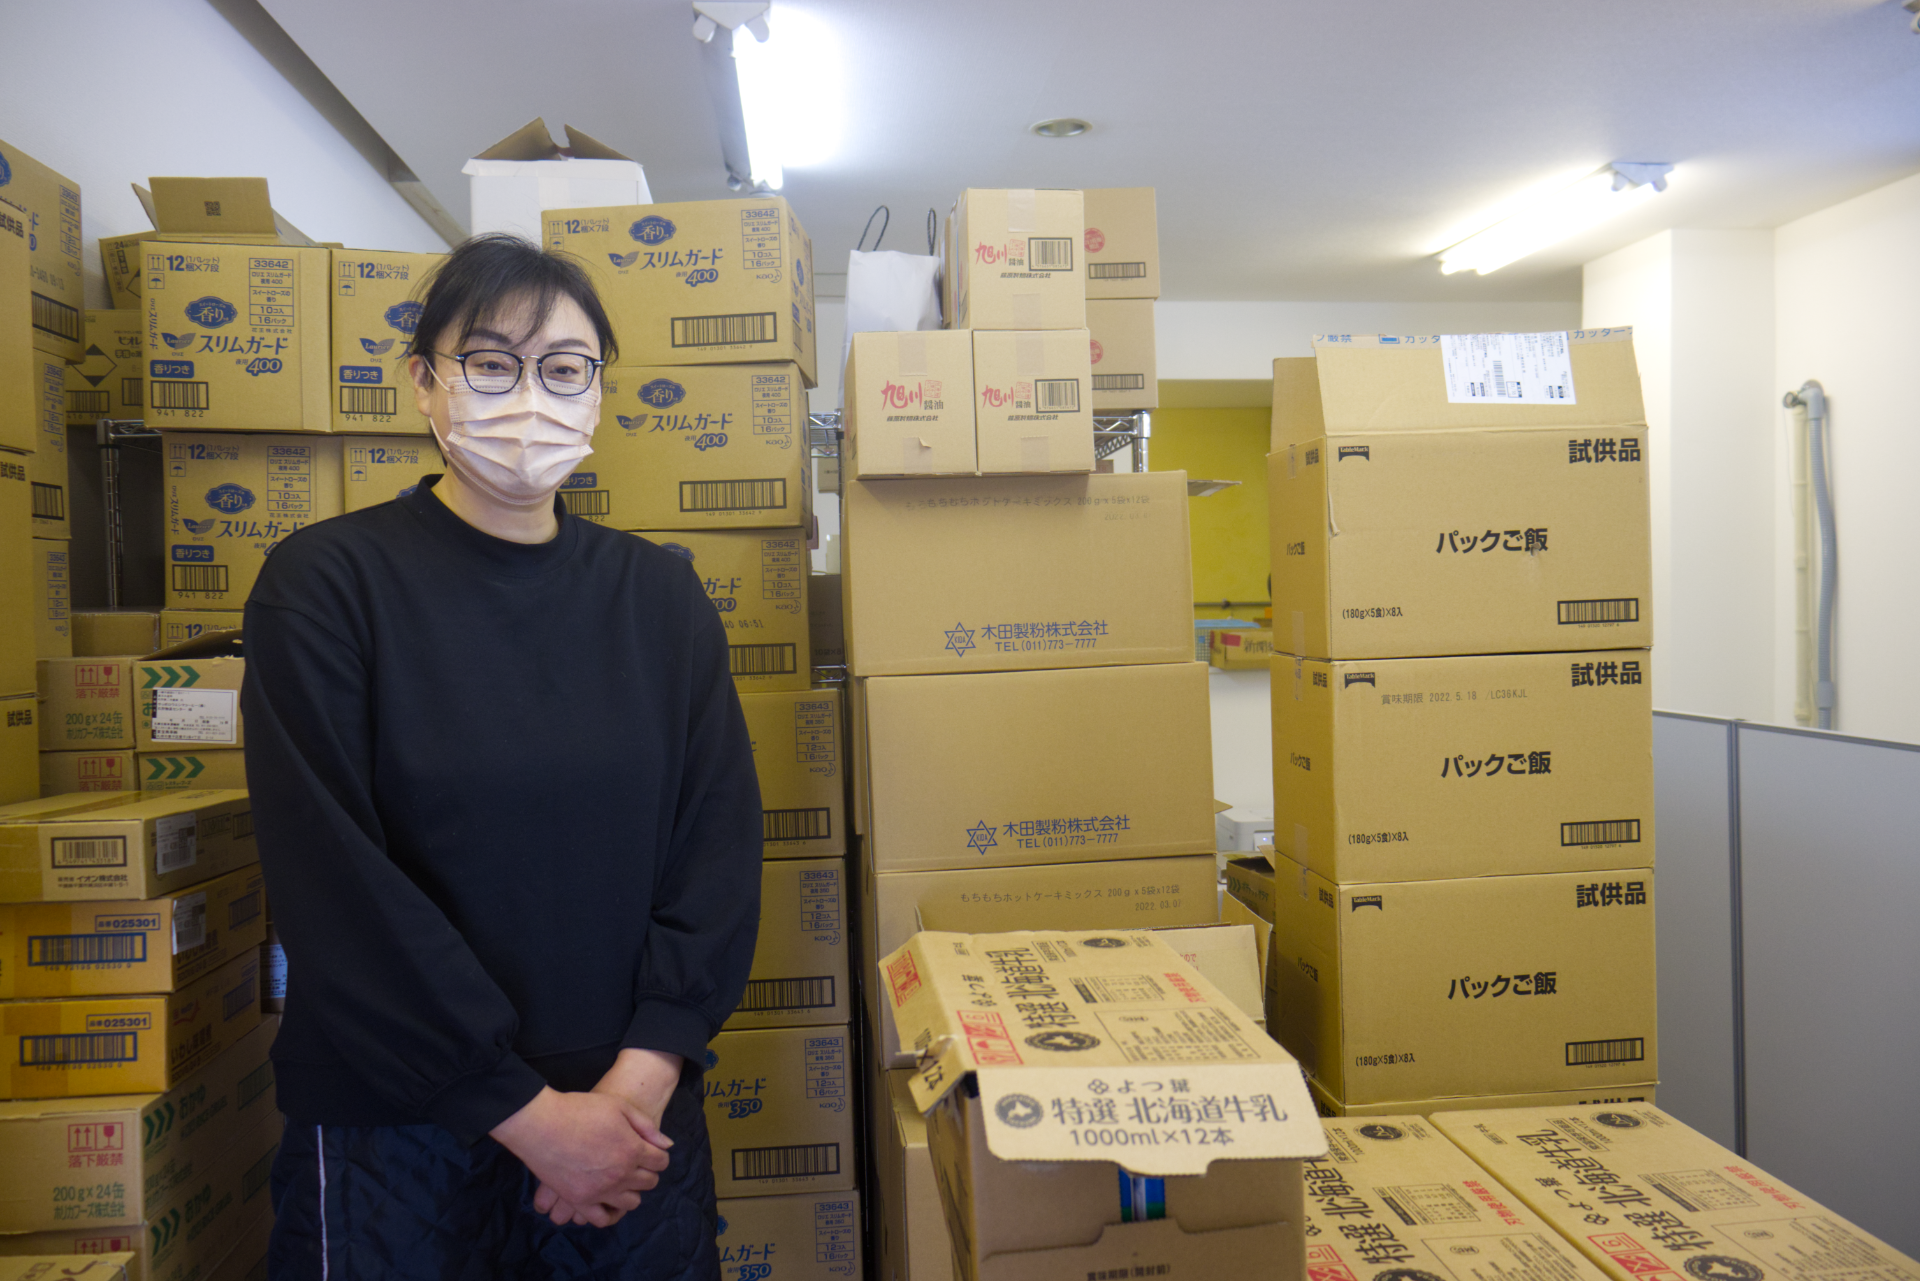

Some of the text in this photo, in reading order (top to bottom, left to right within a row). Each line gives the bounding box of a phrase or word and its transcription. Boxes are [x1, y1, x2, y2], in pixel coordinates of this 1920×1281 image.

[565, 220, 580, 234] 12
[167, 255, 184, 271] 12
[640, 249, 723, 270] スリムガード
[975, 242, 1007, 264] 旭川
[254, 260, 288, 268] 33642
[357, 263, 375, 278] 12
[685, 269, 718, 287] 400
[196, 335, 288, 355] スリムガード
[154, 364, 190, 374] 香りつき
[246, 358, 282, 376] 400
[343, 370, 378, 380] 香りつき
[881, 380, 923, 411] 旭川
[981, 385, 1014, 408] 旭川
[648, 413, 733, 433] スリムガード
[188, 444, 205, 459] 12
[694, 433, 728, 451] 400
[1568, 438, 1641, 464] 試供品
[368, 449, 385, 463] 12
[1436, 528, 1548, 554] パックご飯
[176, 549, 210, 558] 香りつき
[185, 624, 202, 638] 12
[739, 620, 764, 628] 06:51
[981, 620, 1109, 640] 木田製粉株式会社
[1571, 660, 1642, 688] 試供品
[76, 688, 120, 698] 落下厳禁
[1381, 693, 1424, 705] 賞味期限
[7, 710, 32, 727] 試供品
[1441, 751, 1551, 778] パックご飯
[1003, 814, 1130, 837] 木田製粉株式会社
[960, 889, 1102, 902] もちもちホットケーキミックス
[1576, 881, 1646, 908] 試供品
[987, 948, 1056, 998] 北海道牛乳
[1448, 972, 1557, 1000] パックご飯
[1016, 1002, 1077, 1028] 特選
[1118, 1079, 1190, 1094] よつ葉
[728, 1098, 762, 1119] 350
[1051, 1097, 1120, 1125] 特選
[1126, 1094, 1288, 1124] 北海道牛乳
[1070, 1127, 1234, 1146] 1000ml×12本
[68, 1153, 123, 1168] 落下厳禁
[1519, 1130, 1650, 1206] 北海道牛乳
[1536, 1178, 1593, 1210] よつ葉
[1725, 1166, 1804, 1209] 刃物使用厳禁
[820, 1203, 848, 1211] 33643
[1463, 1181, 1522, 1225] 刃物使用厳禁
[1625, 1211, 1713, 1251] 特選
[1339, 1224, 1413, 1264] 特選
